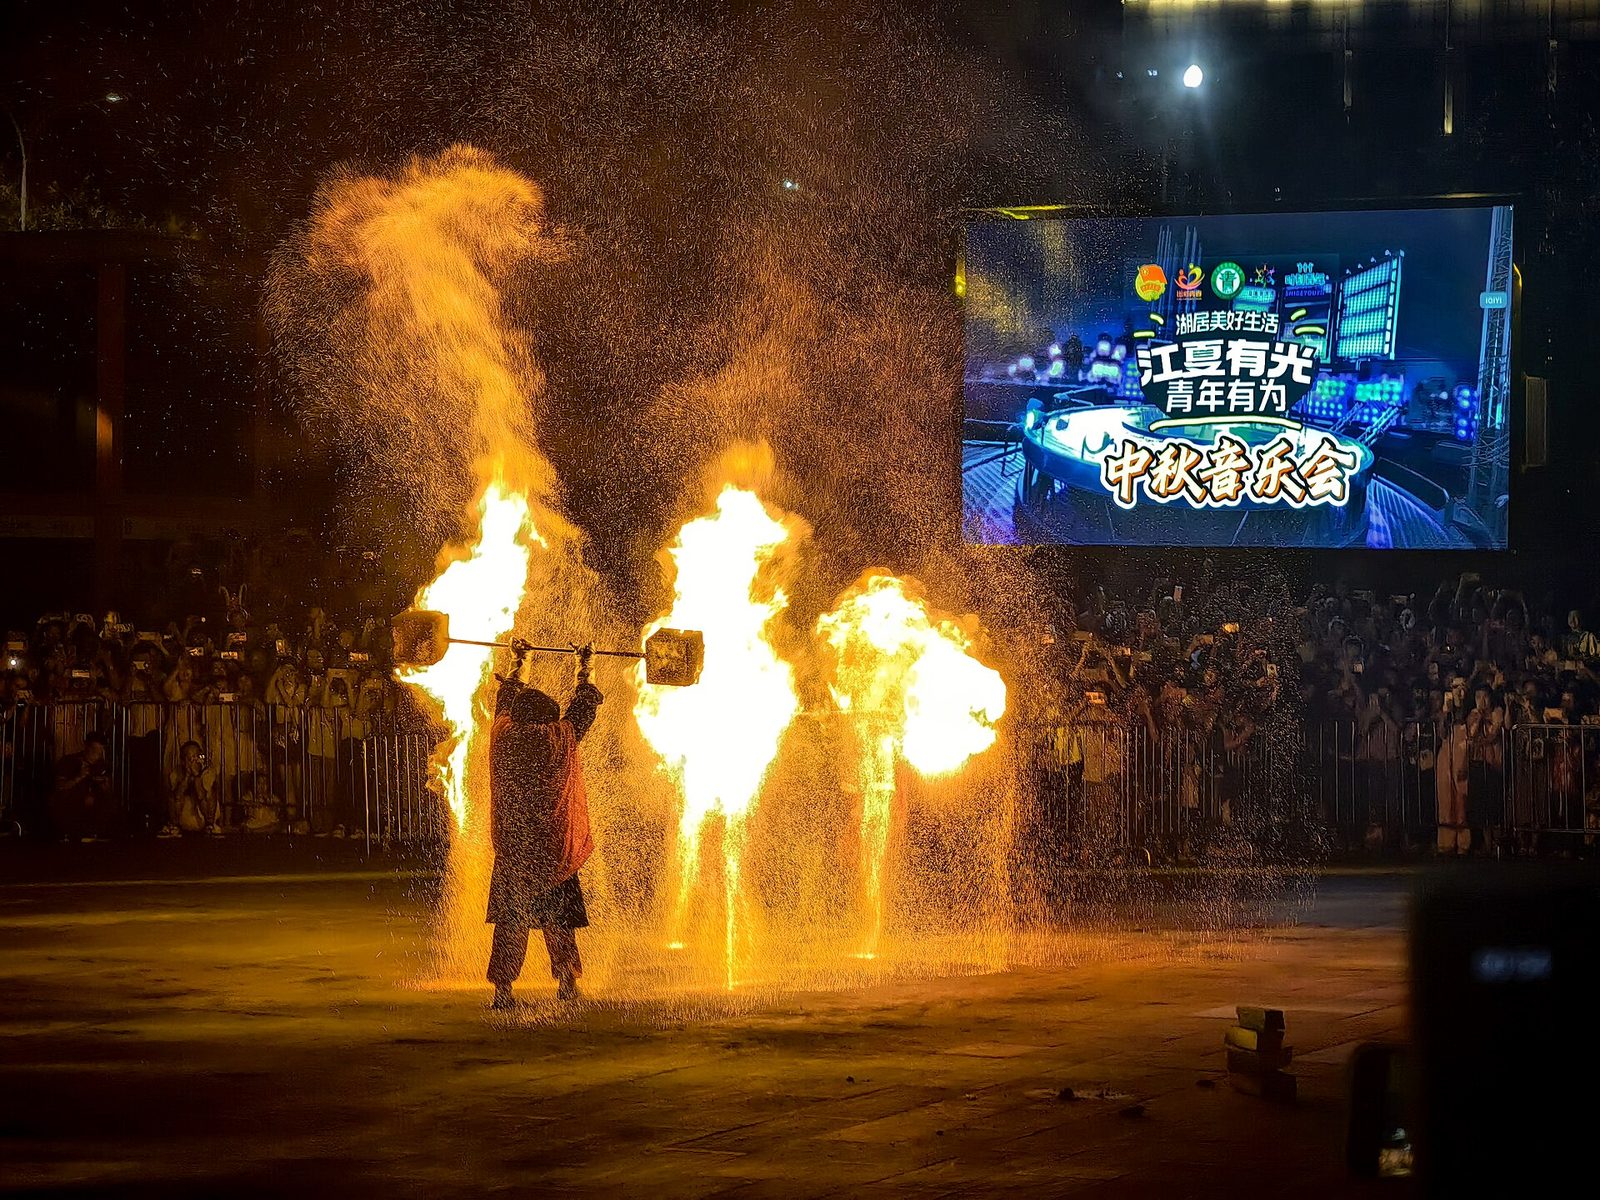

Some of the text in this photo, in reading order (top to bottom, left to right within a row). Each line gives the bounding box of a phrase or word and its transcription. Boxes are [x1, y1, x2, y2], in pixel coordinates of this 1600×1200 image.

[1176, 310, 1279, 336] 湖居美好生活
[1136, 339, 1314, 385] 江夏有光
[1166, 379, 1286, 413] 青年有为
[1105, 436, 1357, 503] 中秋音乐会
